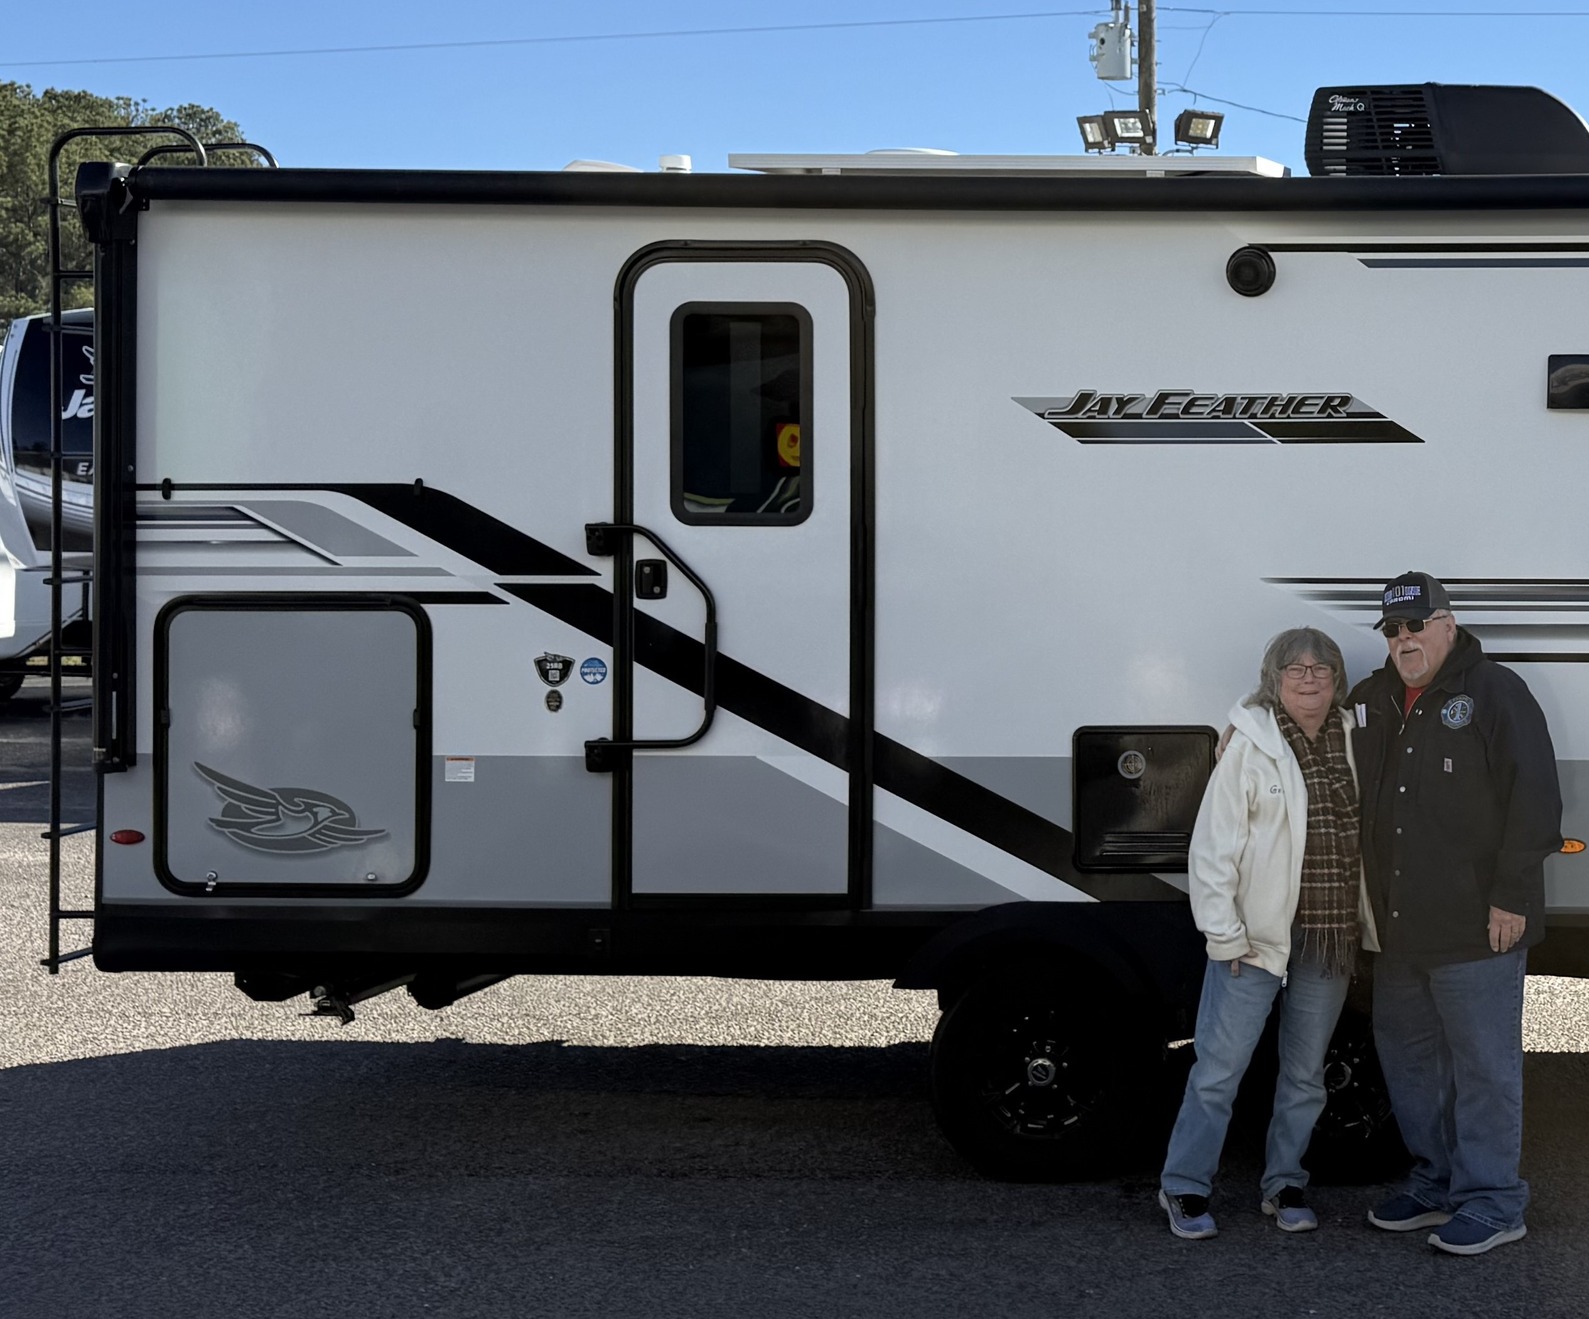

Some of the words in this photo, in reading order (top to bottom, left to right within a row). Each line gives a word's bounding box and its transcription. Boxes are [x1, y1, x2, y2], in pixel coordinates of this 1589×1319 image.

[1357, 103, 1365, 111] Q
[1045, 389, 1145, 418] JAY
[1142, 389, 1352, 418] FEATHER
